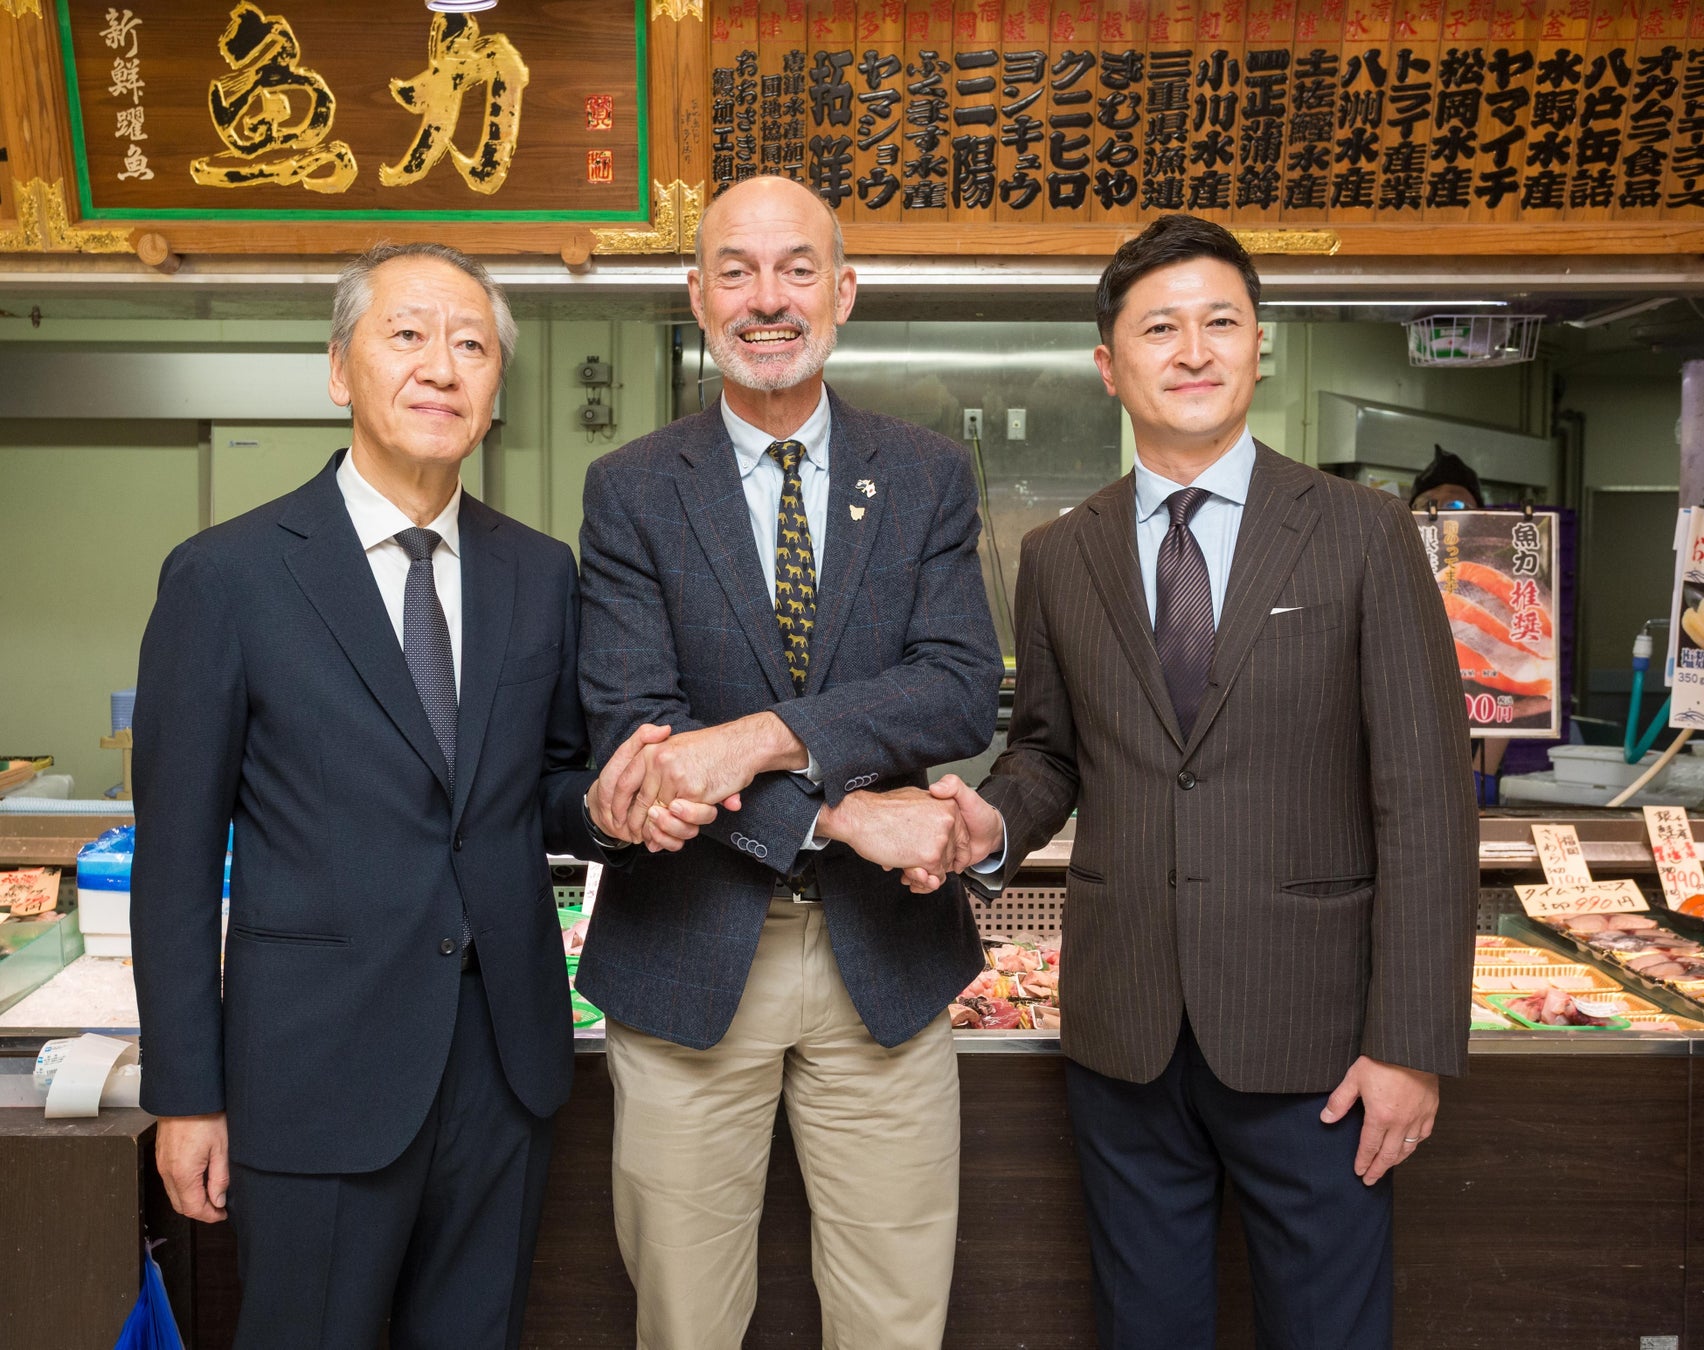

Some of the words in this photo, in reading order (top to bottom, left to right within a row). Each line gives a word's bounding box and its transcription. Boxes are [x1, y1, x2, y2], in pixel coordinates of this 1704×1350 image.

[809, 49, 854, 209] 拓洋
[858, 49, 902, 210] ヤマショウ
[1000, 50, 1047, 210] ヨンキュウ
[1047, 49, 1096, 210] クニヒロ
[1093, 49, 1144, 210] きむらや
[1187, 49, 1240, 210] 小川水産
[1284, 48, 1339, 210] 土佐鰹水産
[1330, 48, 1387, 209] 八洲水産
[1379, 48, 1431, 210] トライ産業
[1426, 47, 1486, 208] 松岡水産
[1474, 48, 1534, 209] ヤマイチ
[1521, 48, 1583, 209] 水野水産
[1569, 48, 1631, 209] 八戸缶詰
[1618, 45, 1683, 209] オカムラ食品
[1510, 522, 1542, 642] 魚力推奨
